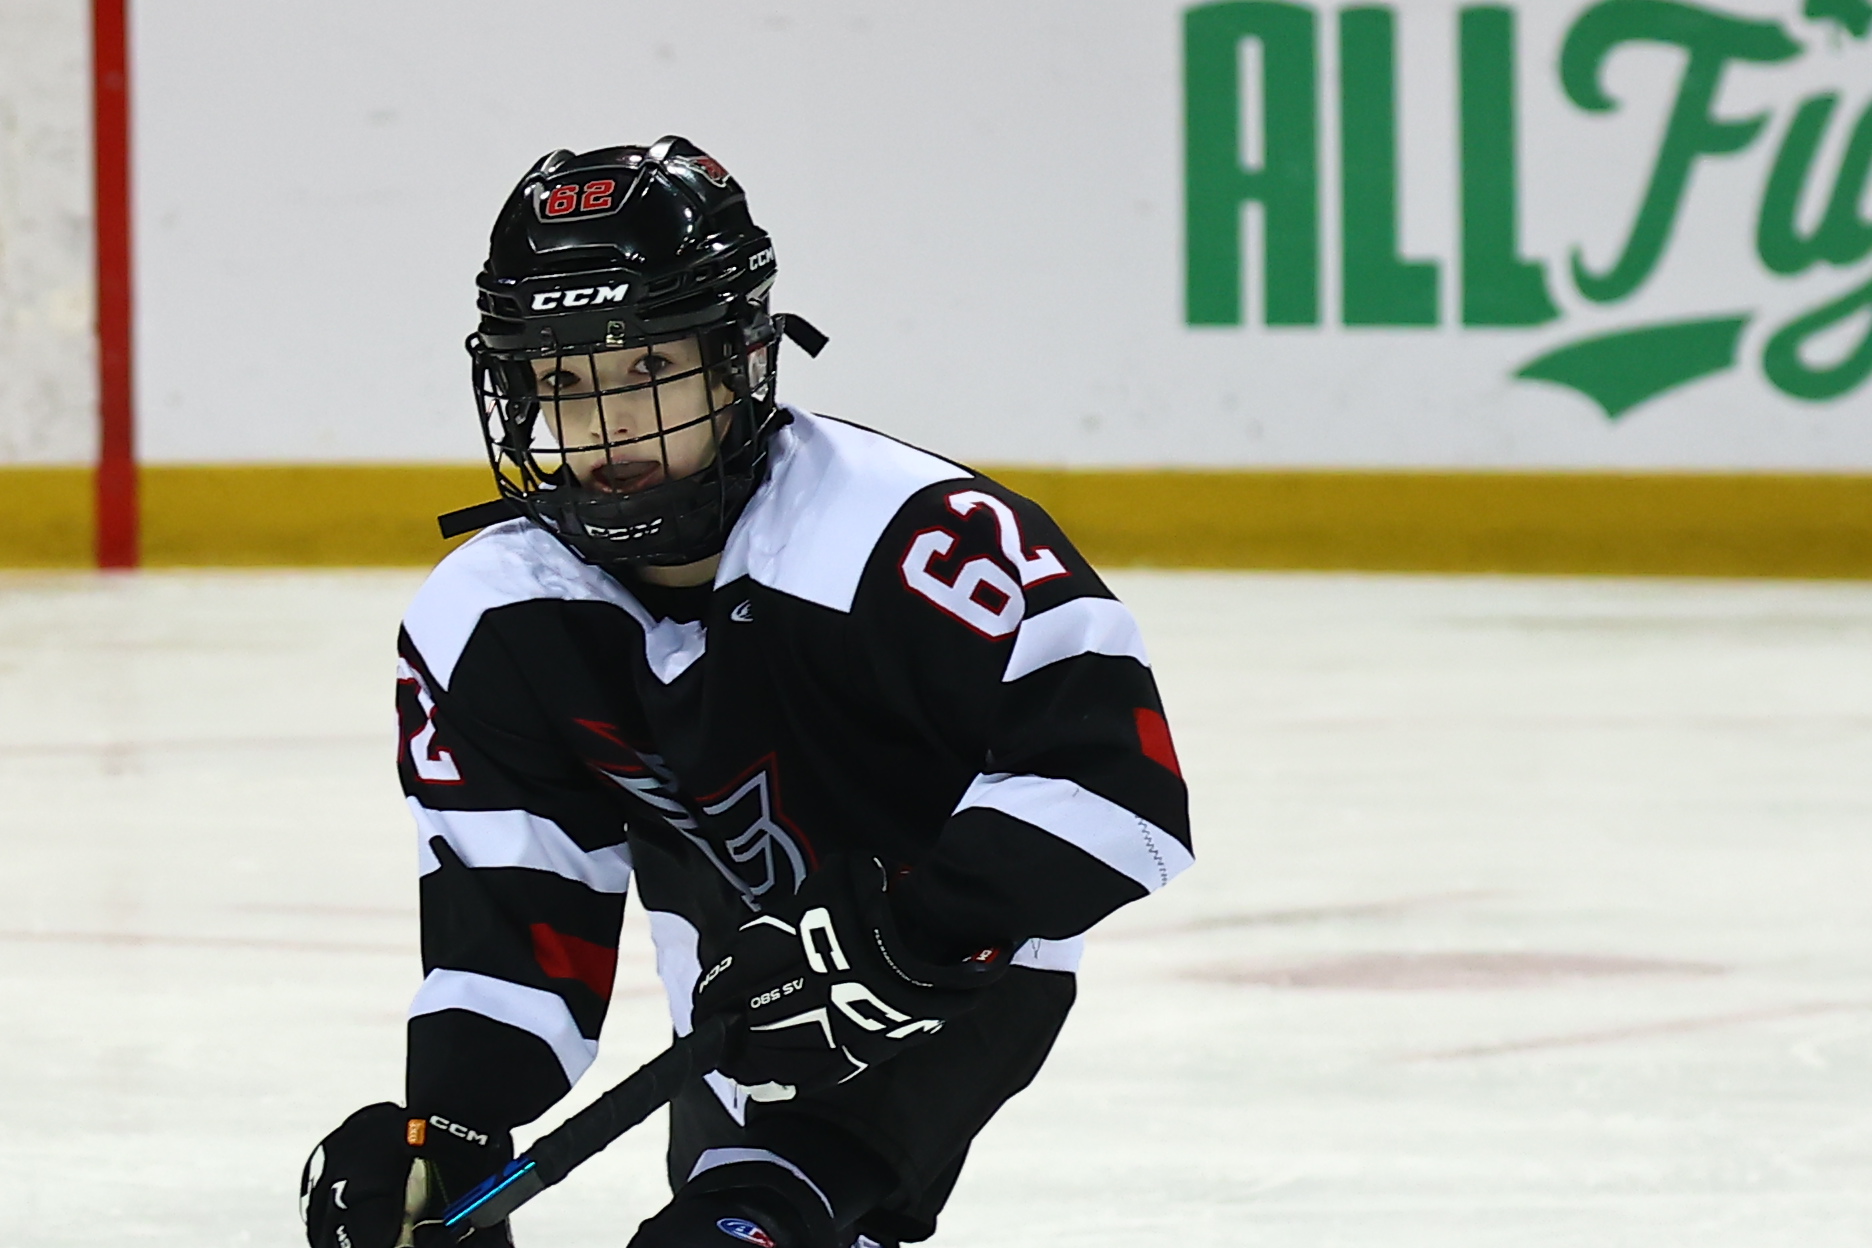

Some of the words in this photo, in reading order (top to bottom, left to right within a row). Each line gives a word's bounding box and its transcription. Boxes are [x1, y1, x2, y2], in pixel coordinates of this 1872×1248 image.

[1181, 0, 1564, 331] ALL
[545, 179, 616, 218] 62
[530, 284, 629, 312] CCM
[896, 489, 1073, 643] 62
[749, 989, 782, 1010] 580
[429, 1114, 489, 1147] CCM
